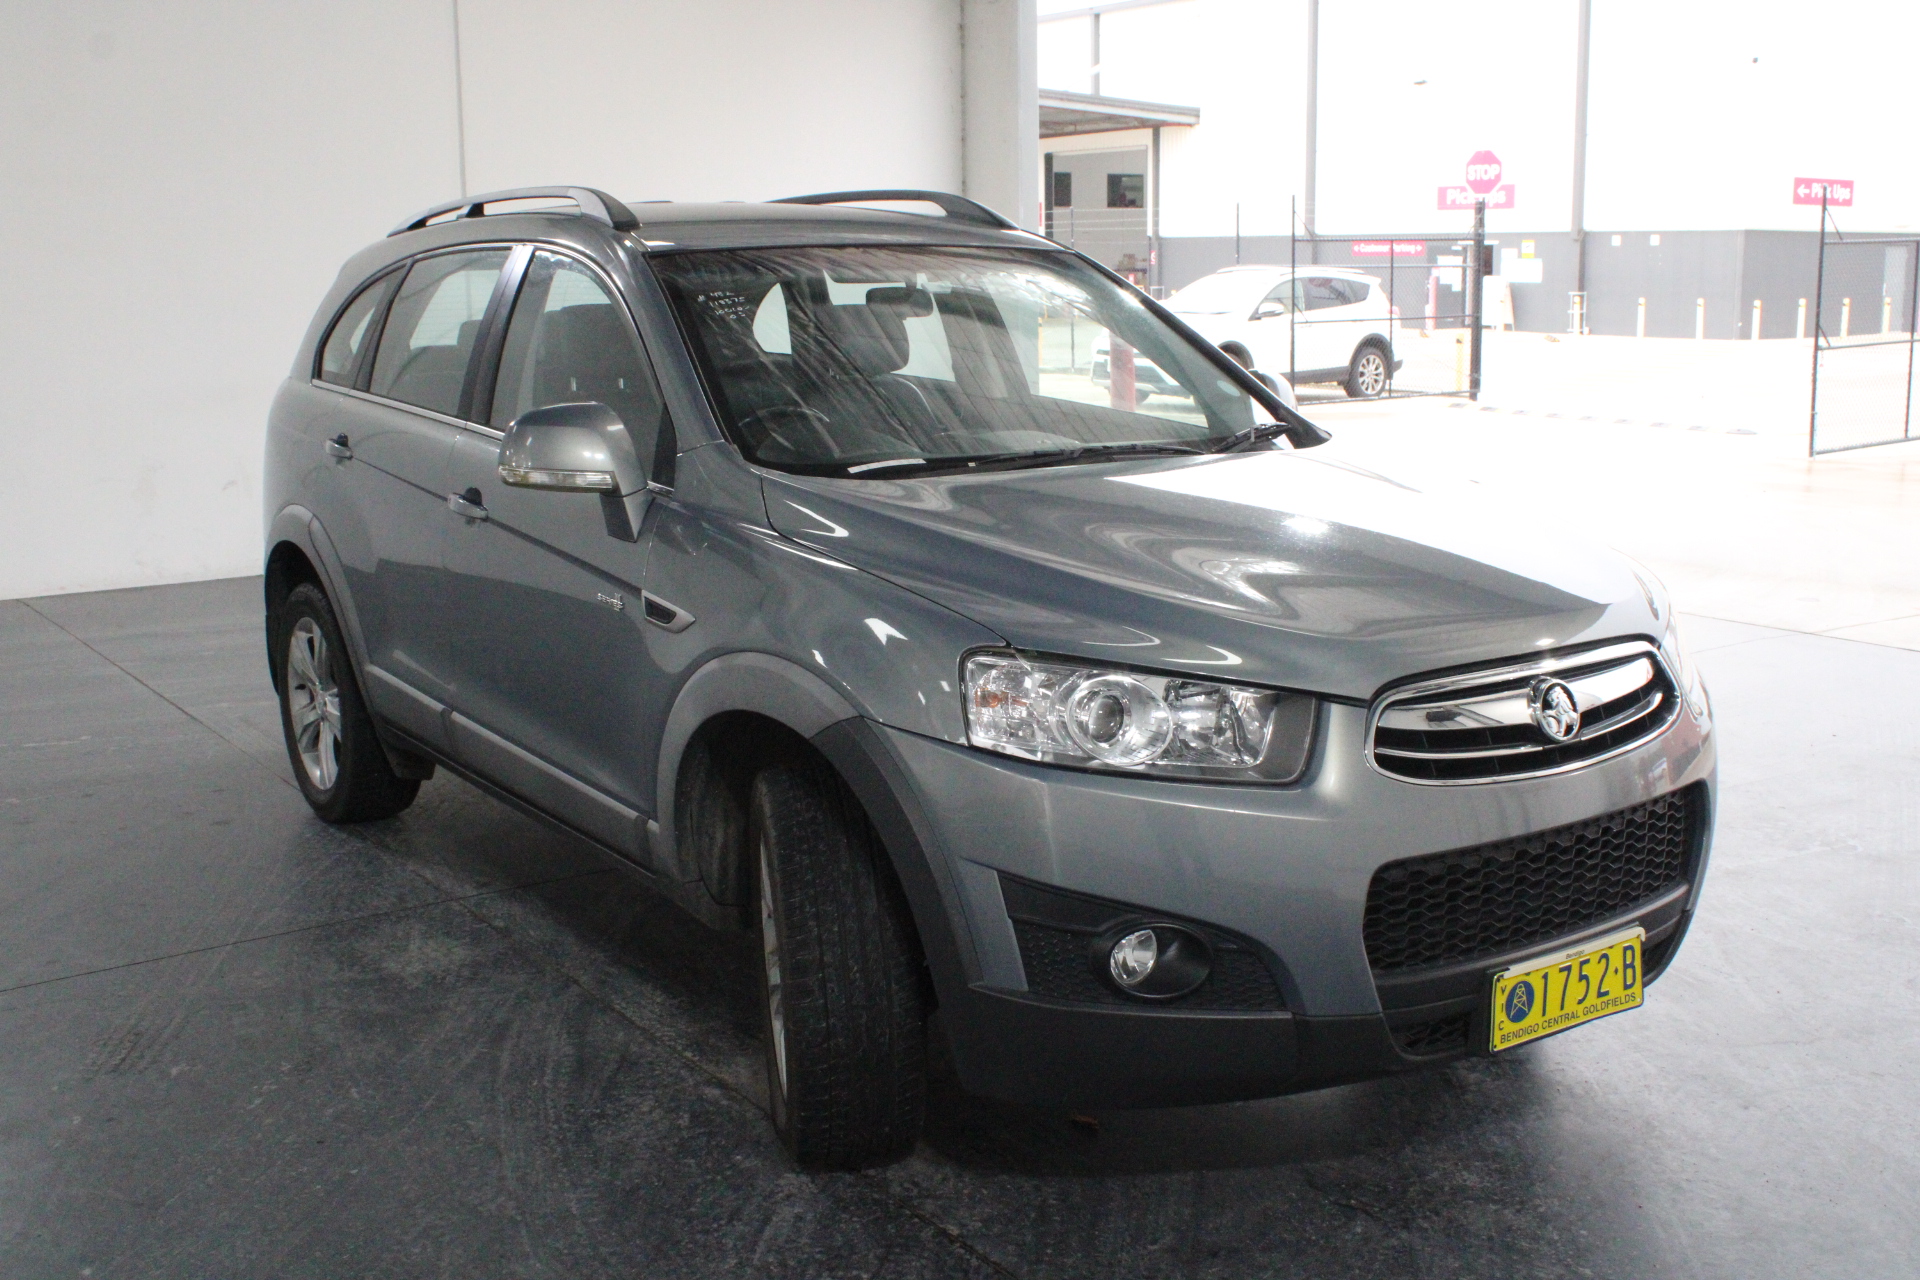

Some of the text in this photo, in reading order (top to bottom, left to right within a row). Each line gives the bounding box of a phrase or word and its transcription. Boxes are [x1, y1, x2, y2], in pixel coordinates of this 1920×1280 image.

[1467, 164, 1500, 181] STOP
[1811, 182, 1851, 203] Pik Ups
[1565, 950, 1586, 960] Bendigo
[1500, 992, 1636, 1044] BENDIGO CENTRAL GOLDFIELDS
